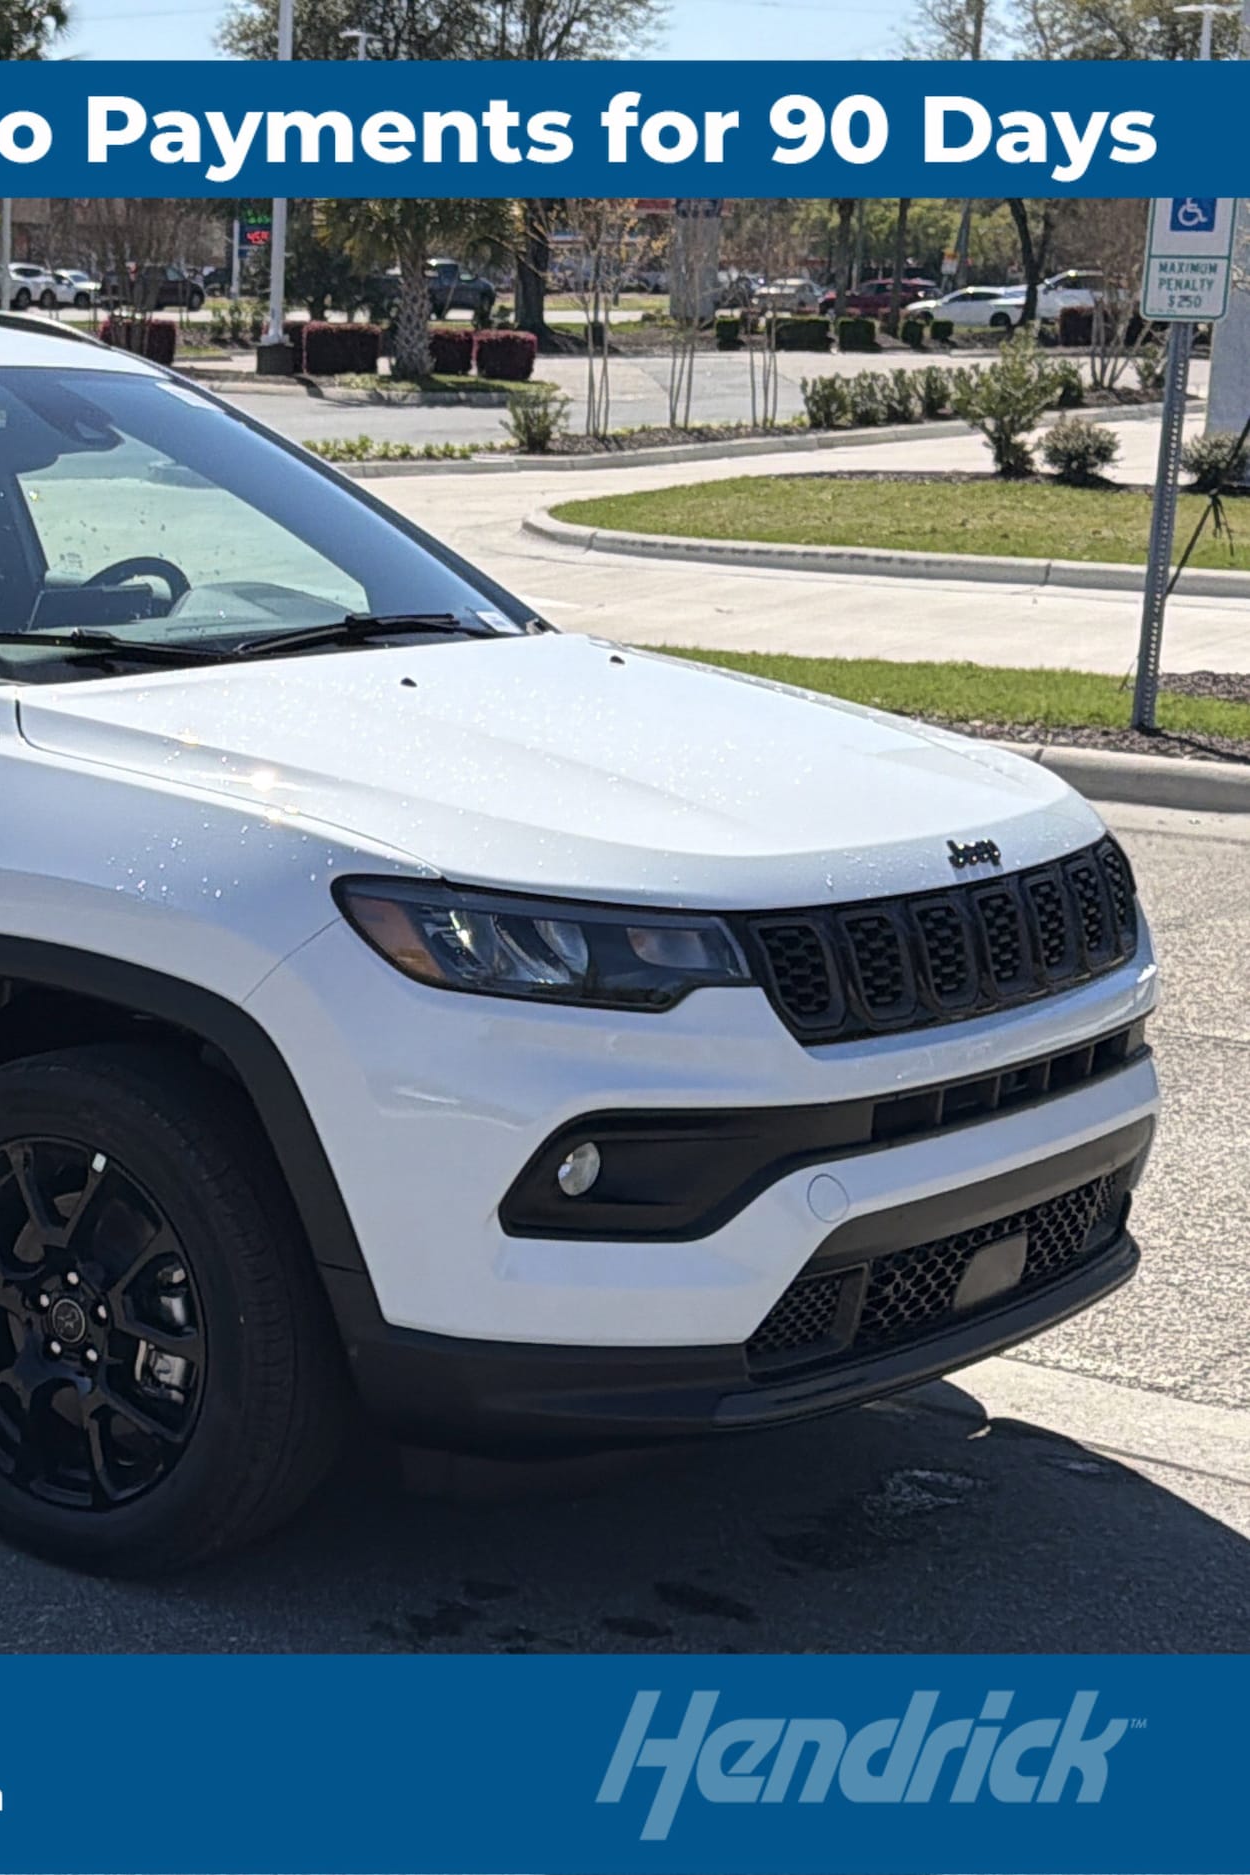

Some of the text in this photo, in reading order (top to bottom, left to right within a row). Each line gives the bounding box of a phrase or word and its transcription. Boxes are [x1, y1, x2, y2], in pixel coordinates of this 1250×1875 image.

[1157, 261, 1218, 275] MAXIMUM
[1156, 277, 1215, 292] PENALTY
[1167, 294, 1203, 309] $250
[946, 839, 1002, 869] Jeep
